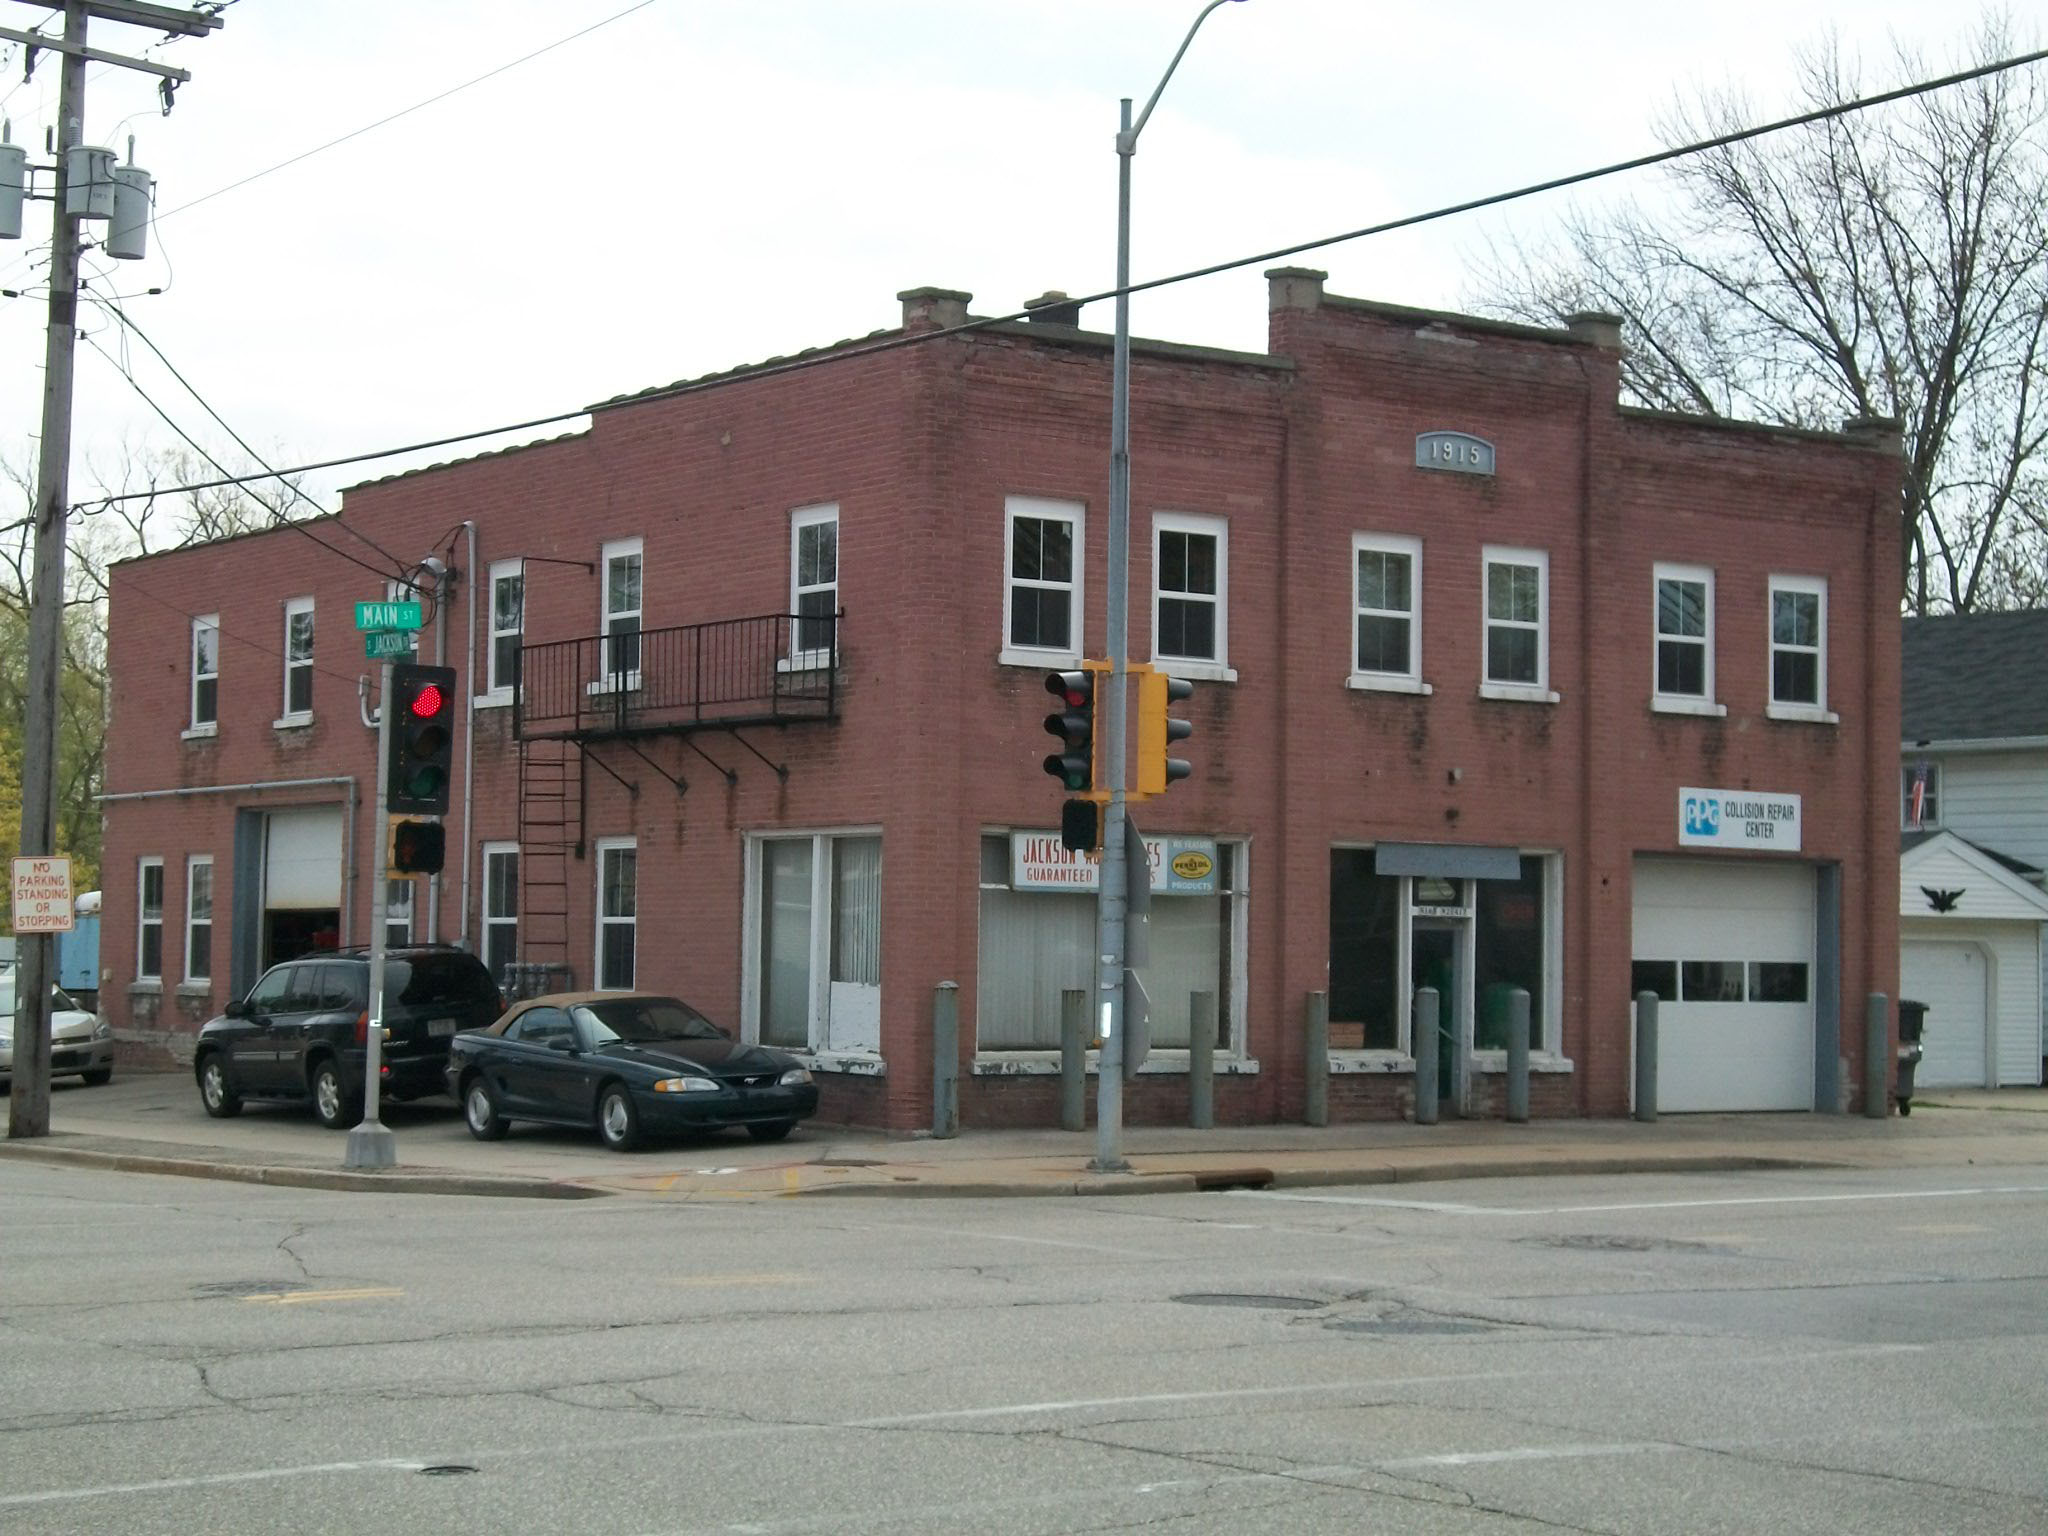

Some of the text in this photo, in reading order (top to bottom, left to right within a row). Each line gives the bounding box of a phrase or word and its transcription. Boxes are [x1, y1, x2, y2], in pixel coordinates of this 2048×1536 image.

[1431, 441, 1480, 465] 1915
[363, 605, 414, 625] MAIN ST
[1687, 799, 1795, 830] PPG COLLISION REPAIR
[1745, 821, 1775, 839] CENTER
[33, 862, 50, 873] NO
[1026, 867, 1093, 882] GUARANTEED
[19, 875, 65, 887] PARKING
[1171, 881, 1213, 890] PRODUCTS
[17, 889, 69, 900] STANDING
[36, 902, 50, 913] OR
[19, 915, 69, 927] STOPPING
